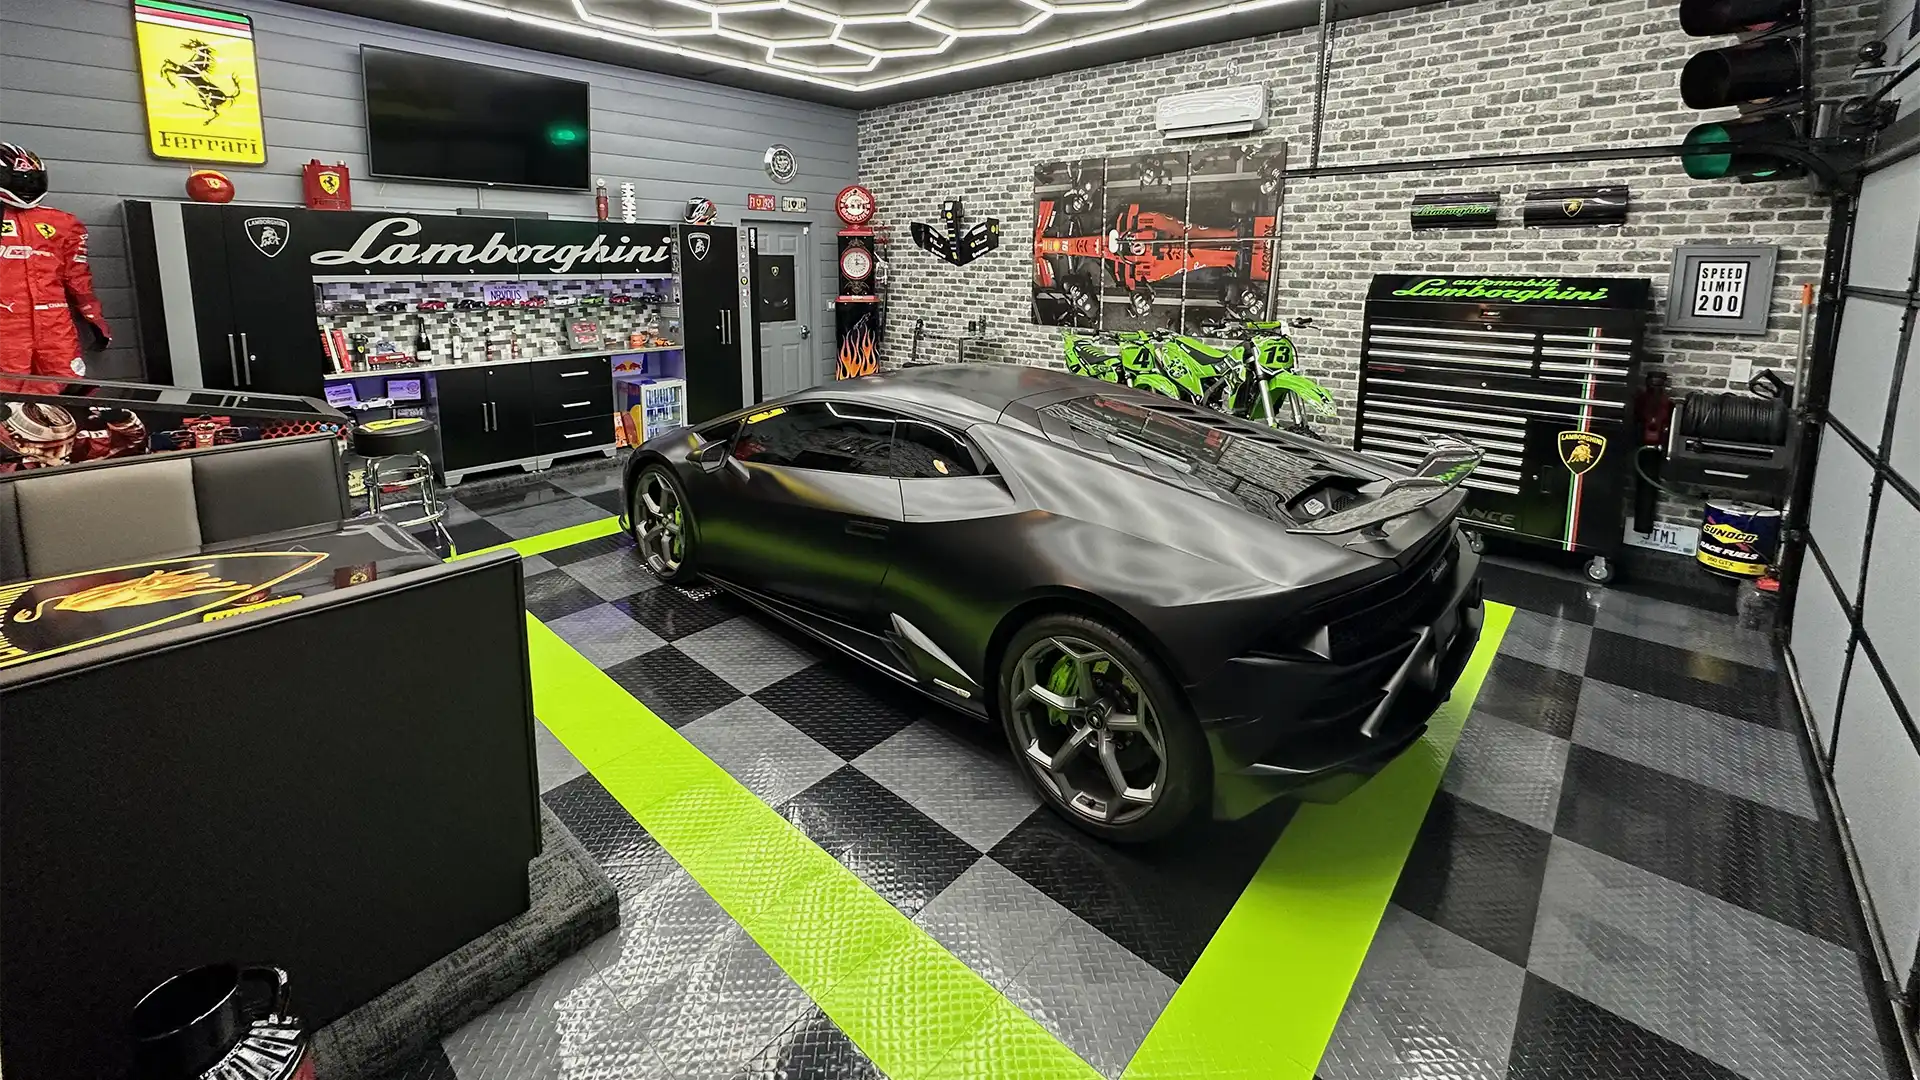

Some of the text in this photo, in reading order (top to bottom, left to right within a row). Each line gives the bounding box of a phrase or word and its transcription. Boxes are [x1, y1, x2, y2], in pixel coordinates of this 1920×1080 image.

[158, 130, 258, 155] Ferrari
[1412, 204, 1491, 217] Lamborghini
[310, 218, 671, 273] Lamborghini
[1452, 278, 1562, 287] automobili
[1701, 268, 1743, 280] SPEED
[1392, 278, 1609, 302] Lamborghini
[1701, 281, 1742, 293] LIMIT
[1698, 295, 1738, 312] 200
[1132, 348, 1151, 368] 4
[1263, 346, 1291, 364] 13
[1561, 434, 1603, 446] LAMBORGHINI
[1704, 525, 1756, 542] SUNOCO
[1700, 541, 1758, 560] RACE FUELS
